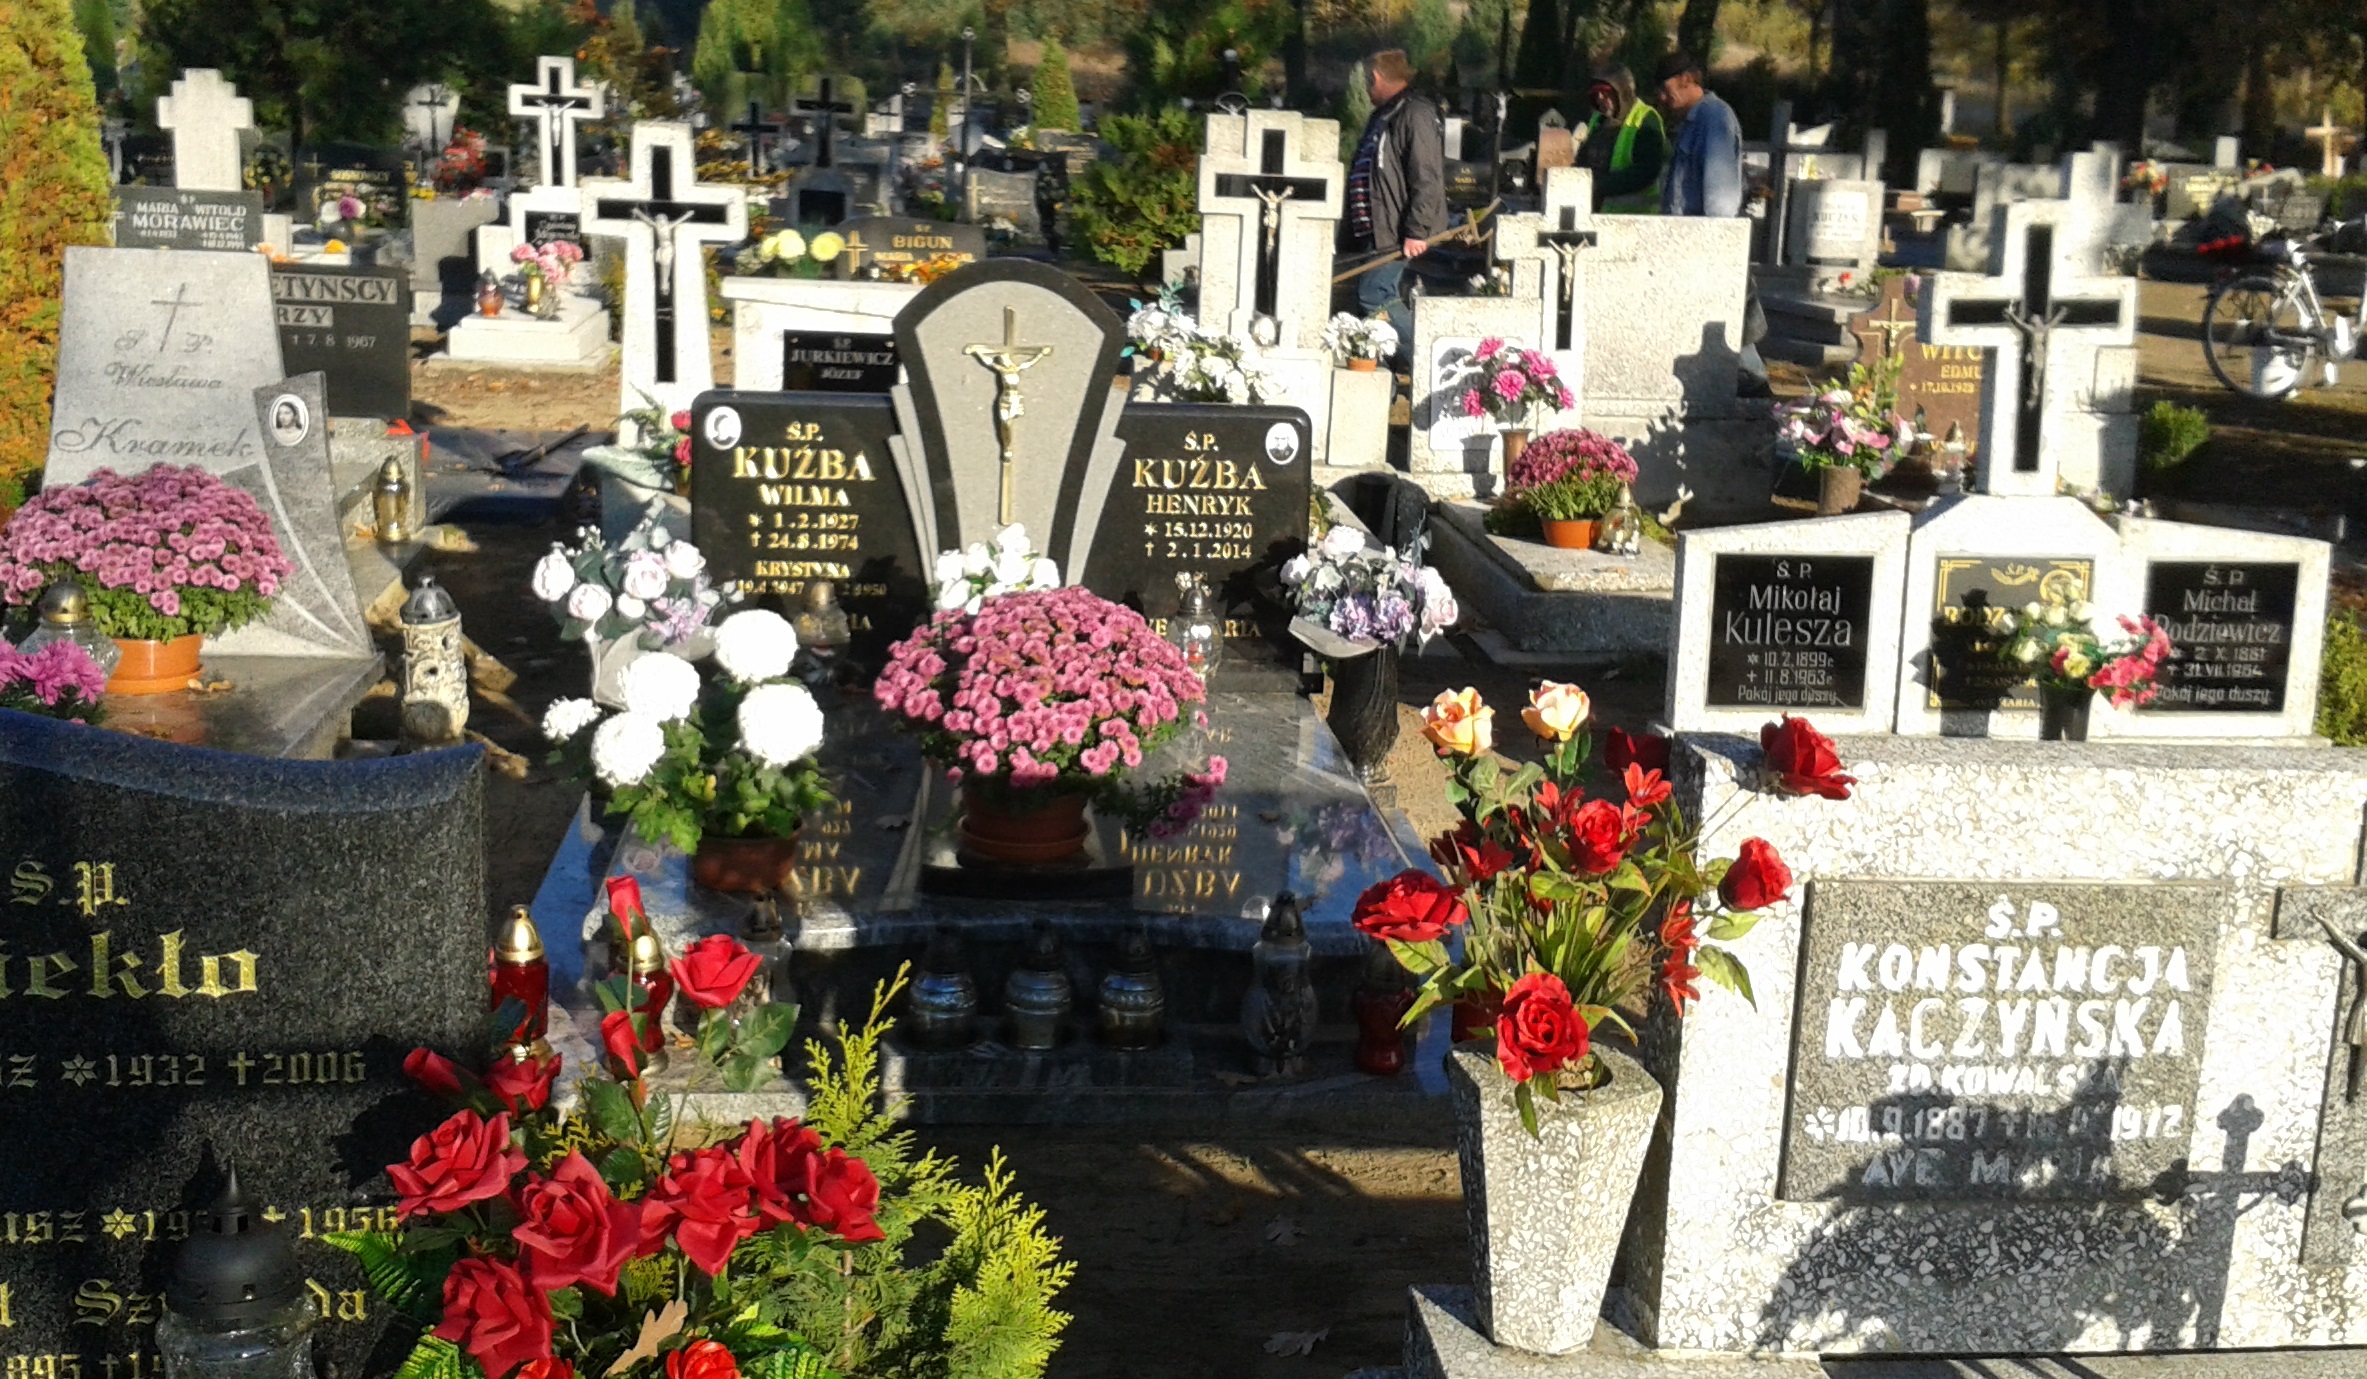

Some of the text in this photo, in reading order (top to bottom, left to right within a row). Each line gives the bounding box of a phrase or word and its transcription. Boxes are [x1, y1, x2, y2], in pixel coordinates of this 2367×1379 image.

[136, 202, 247, 217] MARIA WITOLD
[132, 213, 245, 231] MORAWIEC
[892, 235, 953, 249] BIGUN
[791, 349, 894, 366] JURKIEWICZ
[54, 417, 254, 457] Kramek
[1184, 429, 1220, 451] Ś.P.
[732, 444, 877, 481] KUŹBA
[1132, 454, 1268, 491] KUŹBA
[758, 483, 851, 507] WILMA
[1145, 493, 1254, 516] HENRYK
[1164, 521, 1253, 539] 15.12.1920
[755, 560, 850, 578] KRYSTYNA
[1749, 583, 1841, 615] Mikołaj
[1725, 610, 1852, 647] Kulesza
[1738, 684, 1837, 706] Pokój jego duszy
[2195, 686, 2225, 705] jego
[2229, 685, 2271, 705] duszy
[1836, 942, 2192, 994] KONSTANCJA
[105, 1053, 206, 1088] 1932
[263, 1049, 366, 1085] 2006
